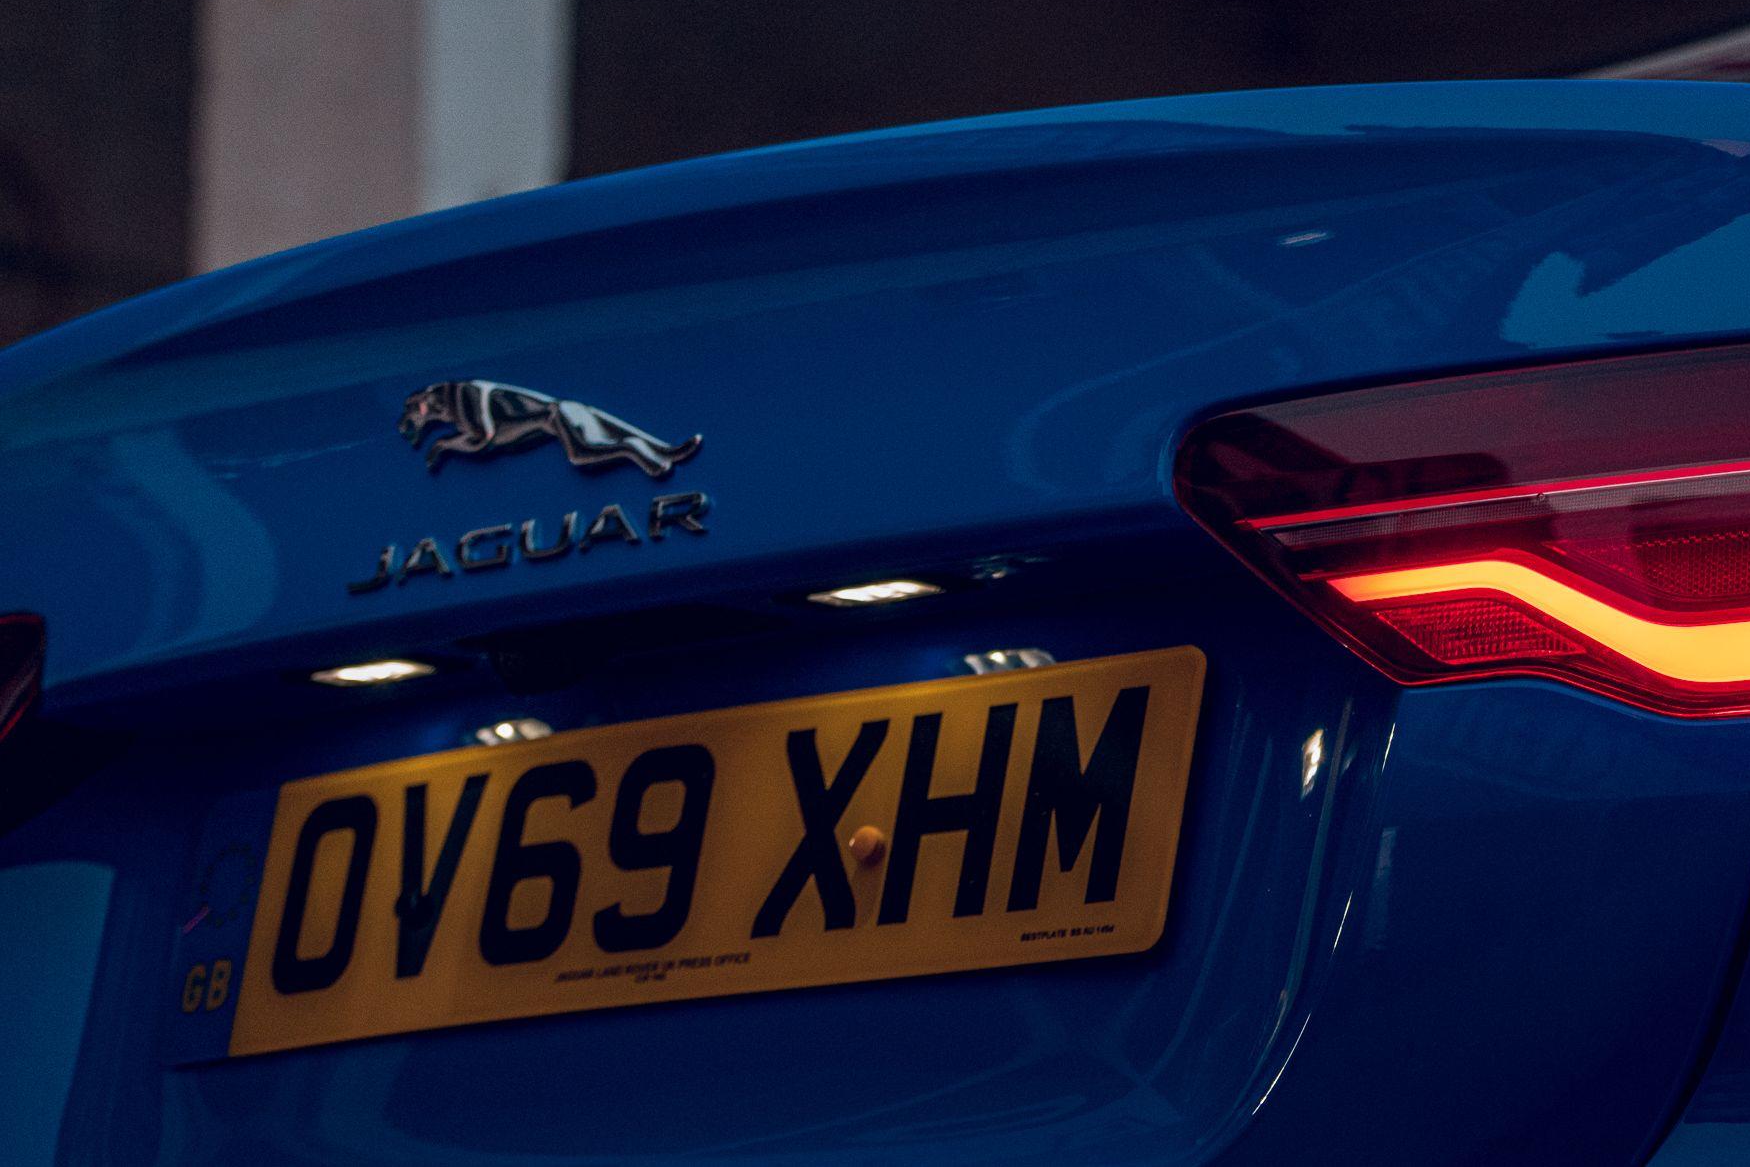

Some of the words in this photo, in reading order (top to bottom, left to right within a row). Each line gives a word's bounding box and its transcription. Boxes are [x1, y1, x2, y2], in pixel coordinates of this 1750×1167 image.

[346, 491, 712, 594] JAGUAR
[270, 743, 717, 996] OV69
[750, 684, 1151, 939] XHM
[181, 958, 232, 1013] GB
